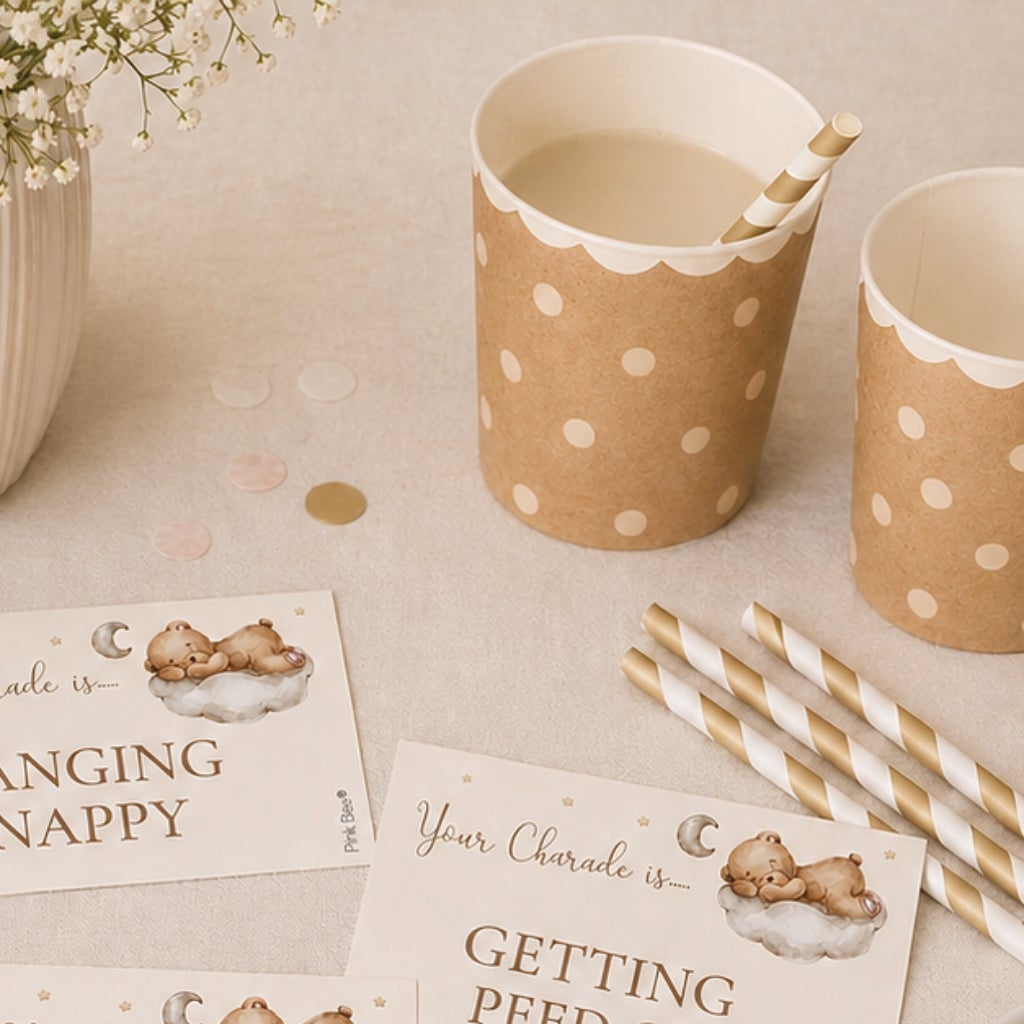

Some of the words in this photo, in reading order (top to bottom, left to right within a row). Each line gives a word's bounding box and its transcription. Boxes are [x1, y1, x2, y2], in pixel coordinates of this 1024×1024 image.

[342, 825, 359, 853] Pink
[416, 800, 496, 857] Your
[508, 821, 634, 879] Charade
[464, 925, 735, 1017] GETTING
